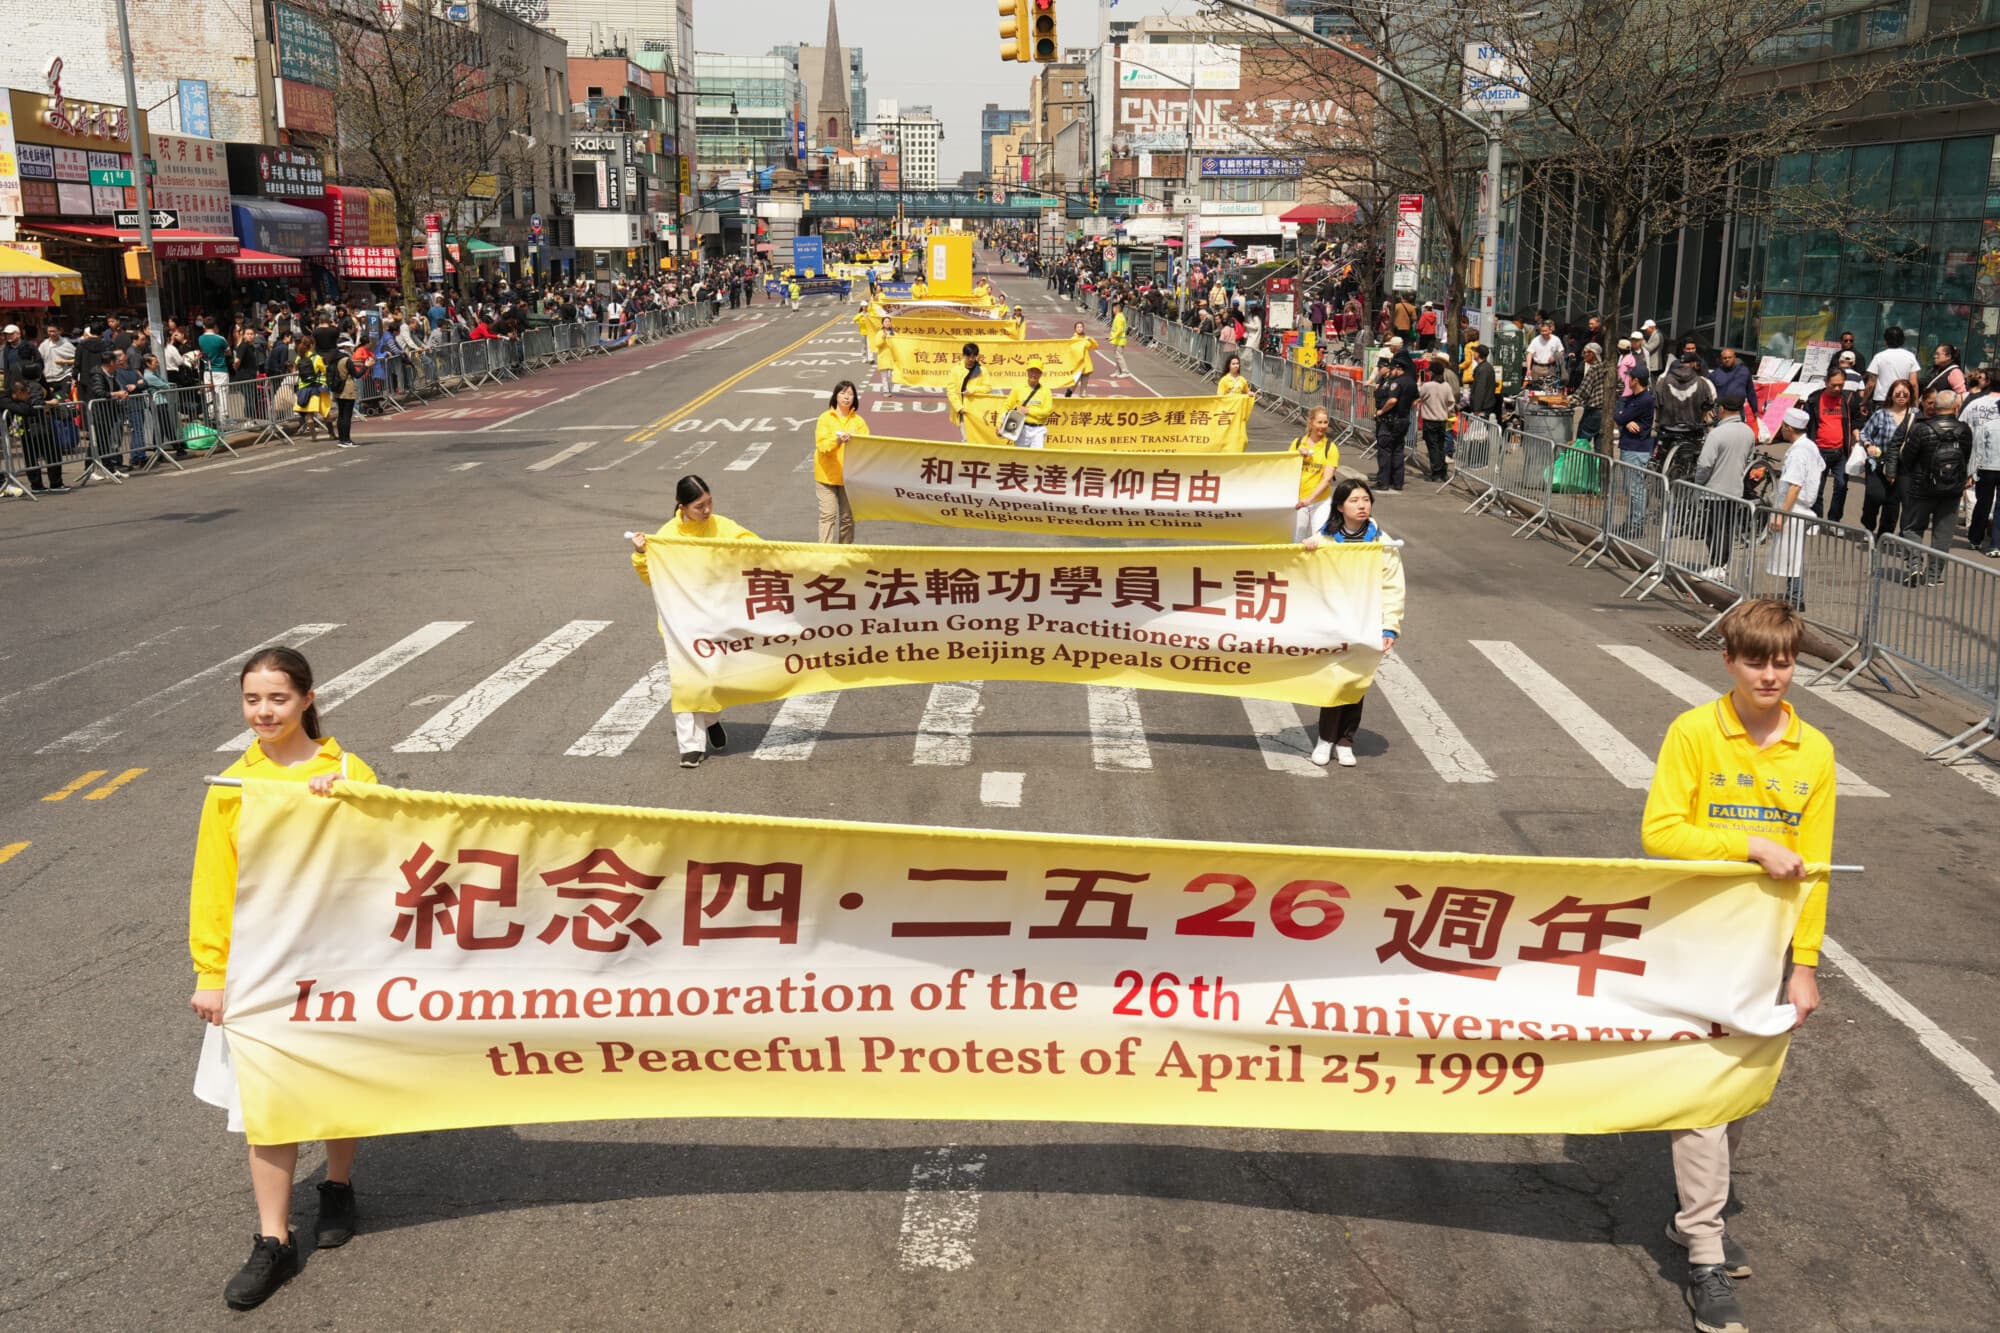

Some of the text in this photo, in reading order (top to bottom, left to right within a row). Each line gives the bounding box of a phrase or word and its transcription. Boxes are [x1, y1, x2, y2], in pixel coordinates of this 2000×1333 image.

[103, 172, 115, 184] 41
[669, 416, 819, 433] ONLY
[920, 456, 1221, 504] 和平表達信仰自由
[894, 487, 1243, 519] Peacefully Appealing for the Basic Right
[940, 508, 1203, 528] of Religious Freedom in China
[742, 566, 1289, 624] 萬名法輪功學員上訪
[693, 635, 754, 659] Over
[860, 617, 938, 635] Falun
[946, 614, 1019, 636] Gong
[1027, 613, 1210, 651] Practitioners
[785, 640, 1251, 675] Outside the Beijing Appeals Office
[1712, 805, 1798, 825] FALUN DAFA
[288, 979, 358, 1022] In
[376, 971, 894, 1022] Commemoration
[910, 968, 975, 1011] of
[987, 967, 1079, 1011] the
[1112, 969, 1241, 1022] 26th
[485, 1036, 1546, 1096] the Peaceful Protest of April 25, 1999
